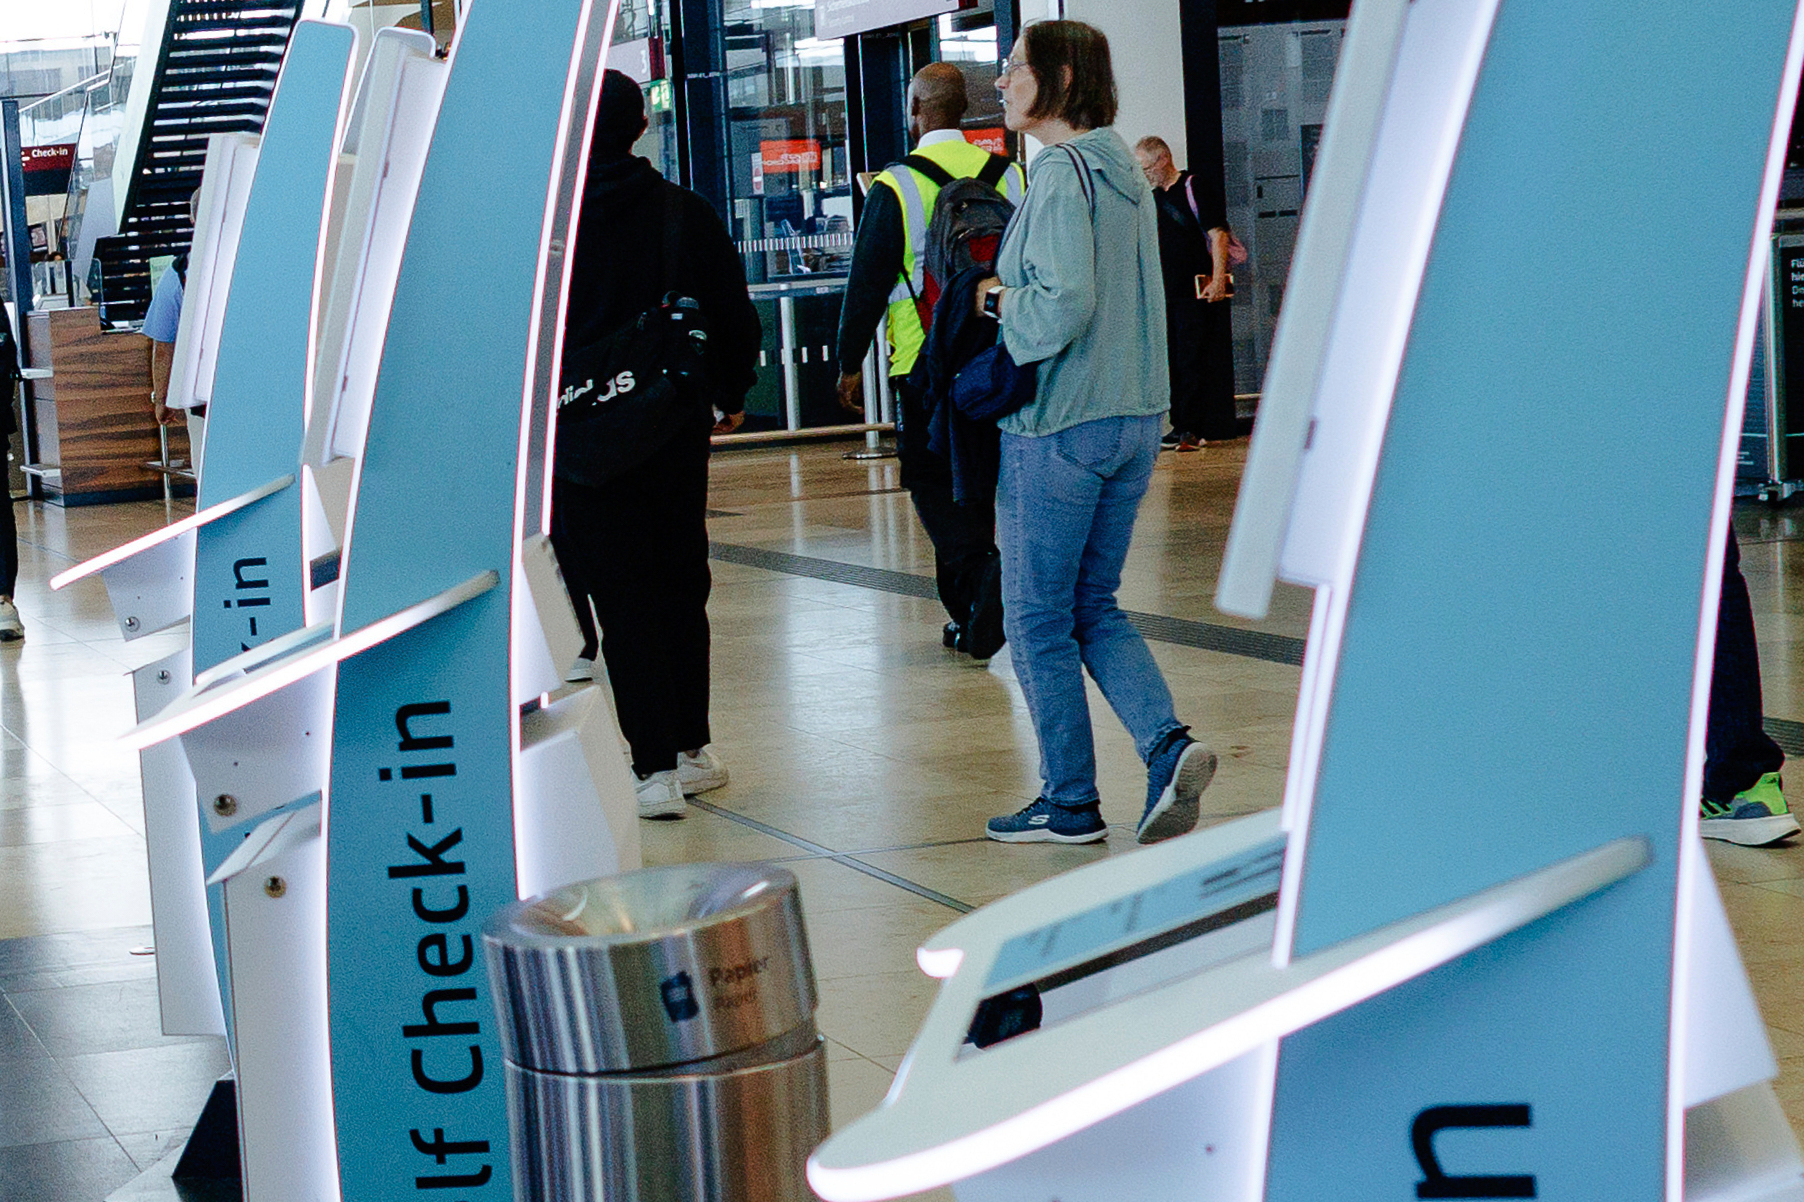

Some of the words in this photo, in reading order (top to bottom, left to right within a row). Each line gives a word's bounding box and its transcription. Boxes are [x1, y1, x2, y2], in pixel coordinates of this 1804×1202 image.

[31, 147, 68, 158] Check-in
[223, 557, 271, 653] -in
[378, 700, 484, 1096] Check-in
